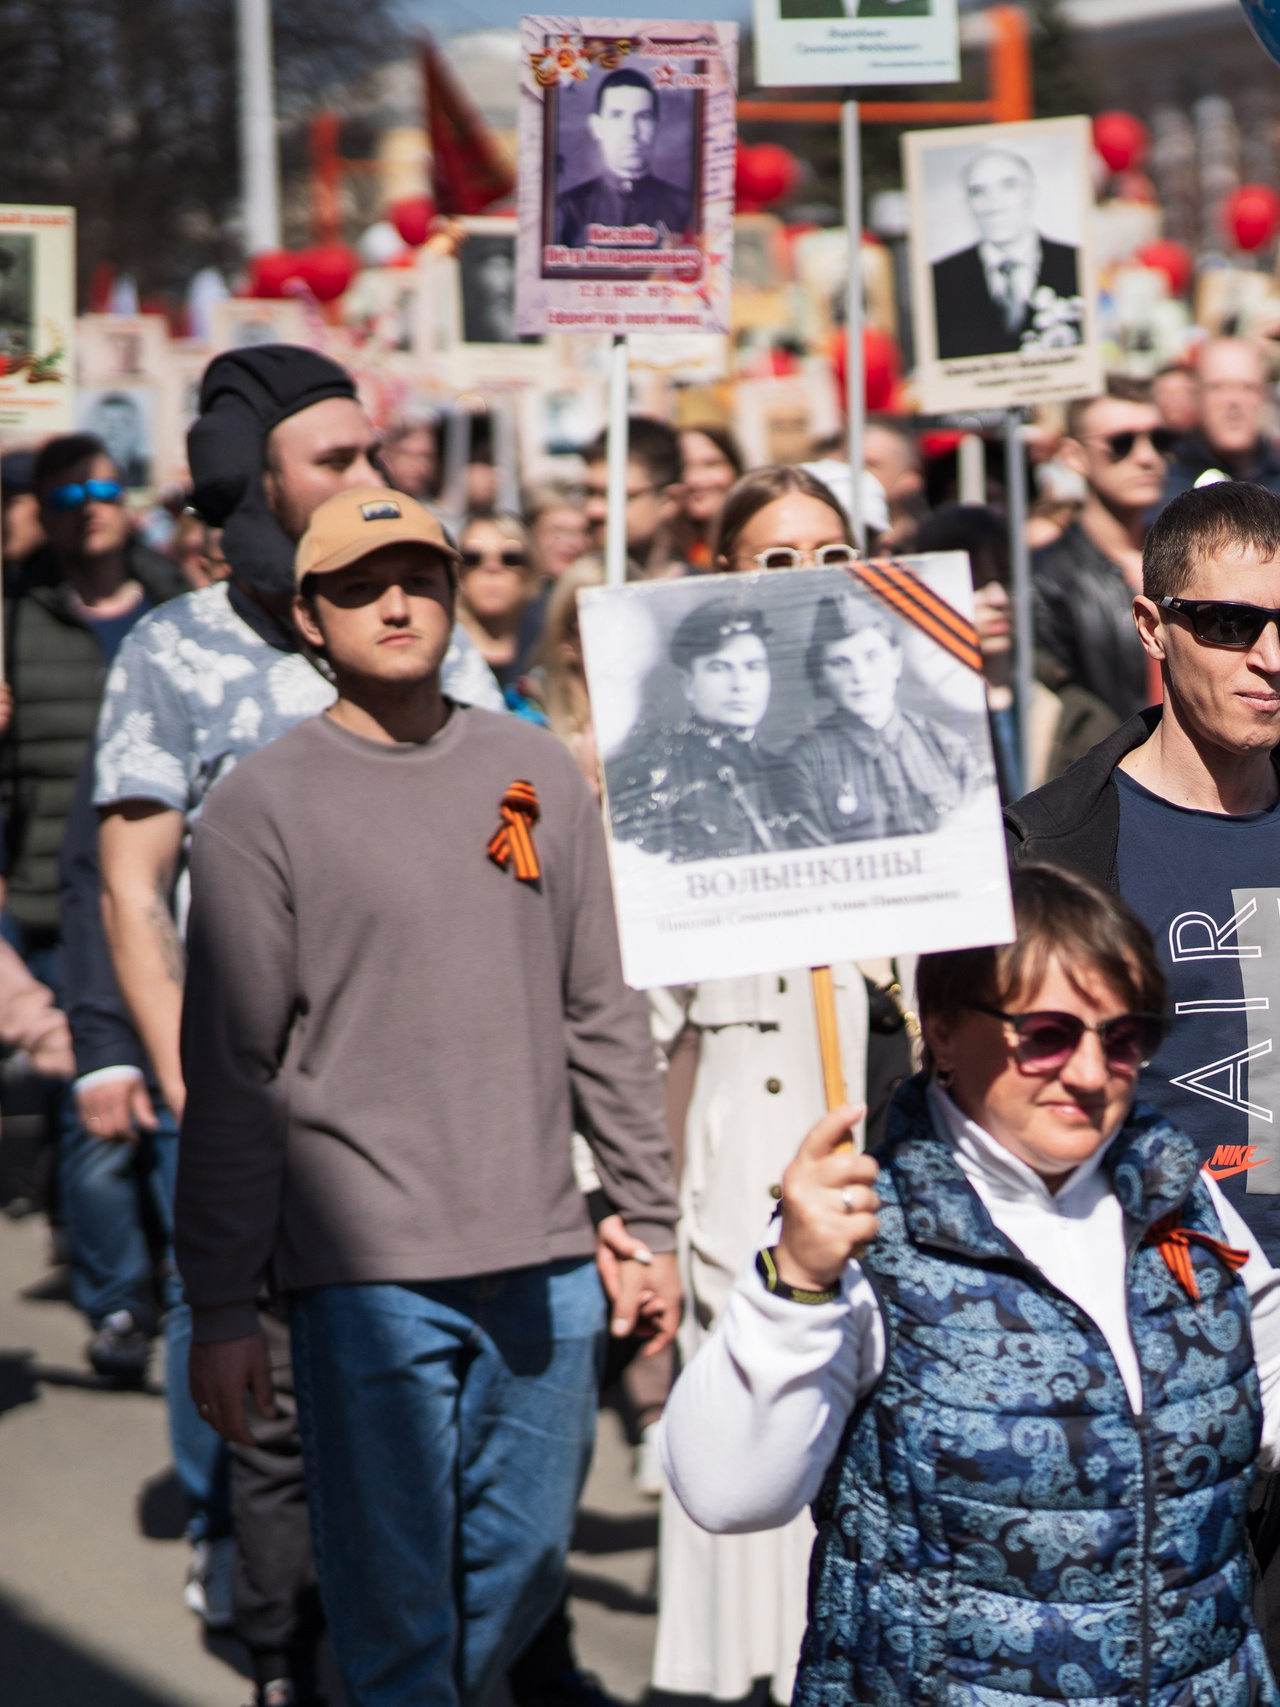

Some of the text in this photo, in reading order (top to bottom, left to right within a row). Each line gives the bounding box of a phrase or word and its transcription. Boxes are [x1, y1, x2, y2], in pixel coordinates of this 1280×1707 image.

[686, 848, 926, 900] ВОЛЫНКИНЫ
[1169, 896, 1273, 1123] AIR
[1210, 1144, 1258, 1167] NIKE
